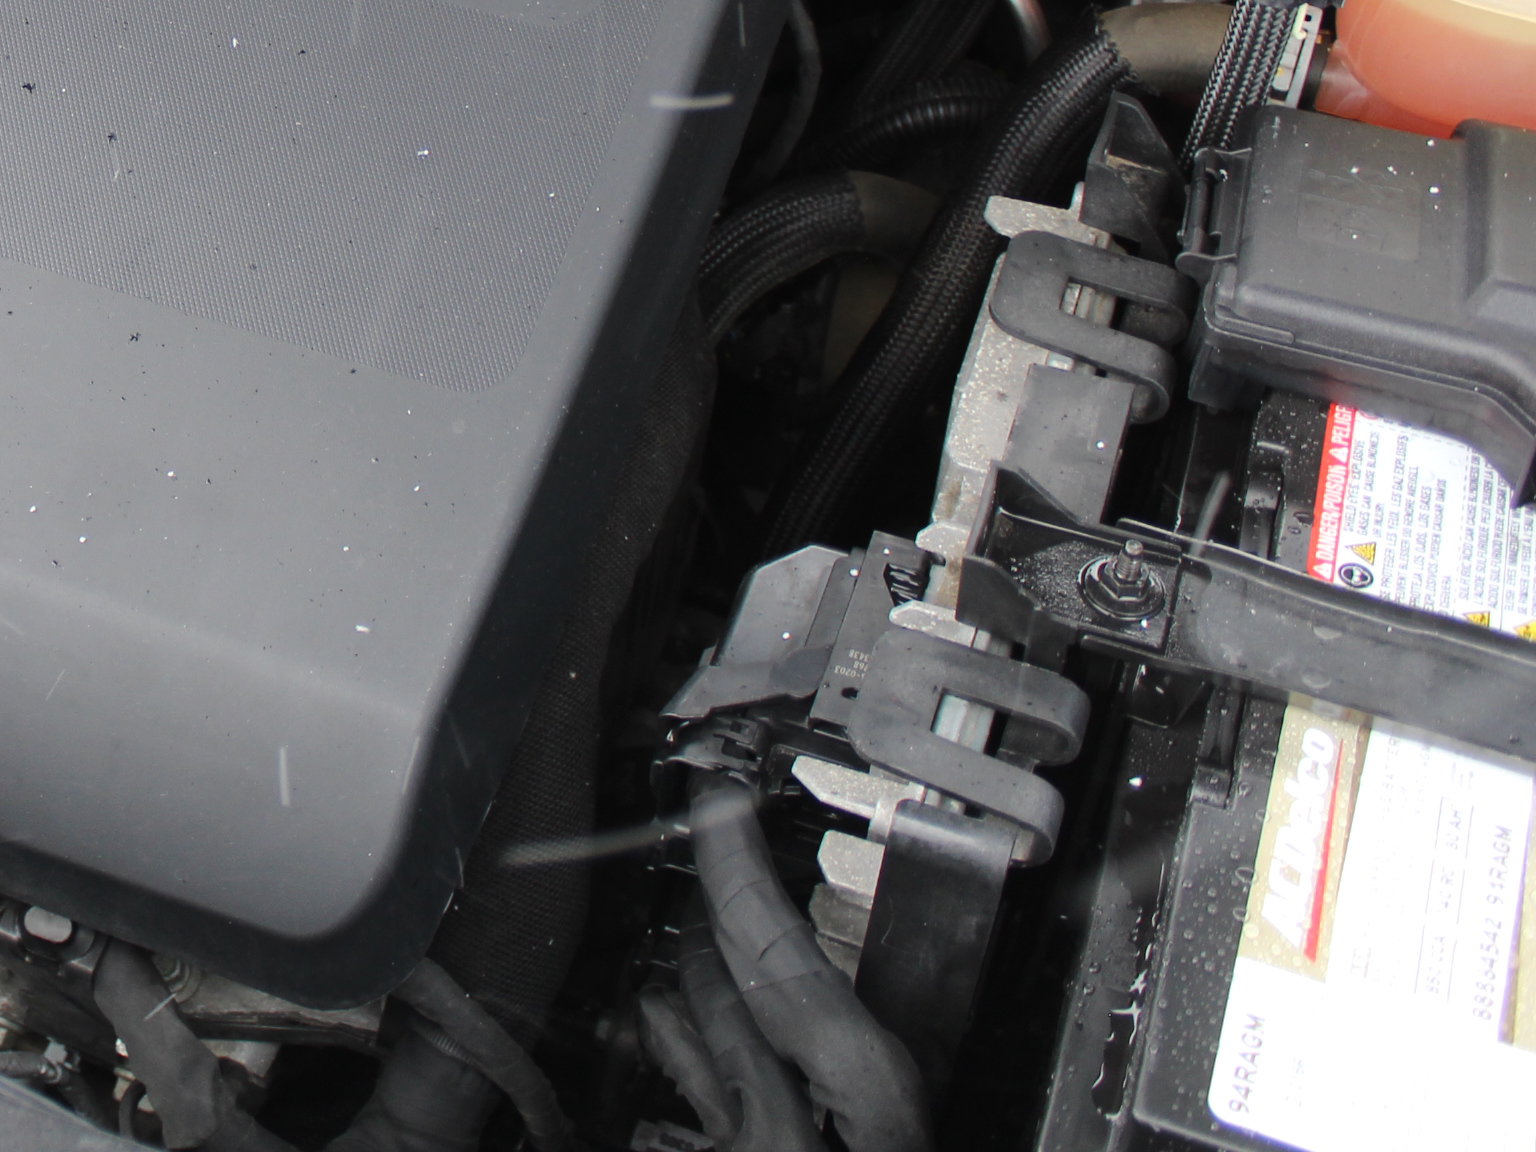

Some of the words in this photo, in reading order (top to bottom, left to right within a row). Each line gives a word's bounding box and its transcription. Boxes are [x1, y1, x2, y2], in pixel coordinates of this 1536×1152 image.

[1362, 468, 1374, 491] CAUSE
[1391, 491, 1401, 507] LES
[1419, 484, 1431, 510] GASES
[1316, 463, 1345, 560] DANGER/POISON
[1357, 510, 1369, 535] GASES
[1418, 512, 1428, 528] LOS
[1386, 531, 1397, 545] LES
[1414, 553, 1424, 569] LOS
[1461, 541, 1472, 561] ACID
[1261, 727, 1334, 947] ACDelco
[1227, 1012, 1265, 1115] 94RAGM
